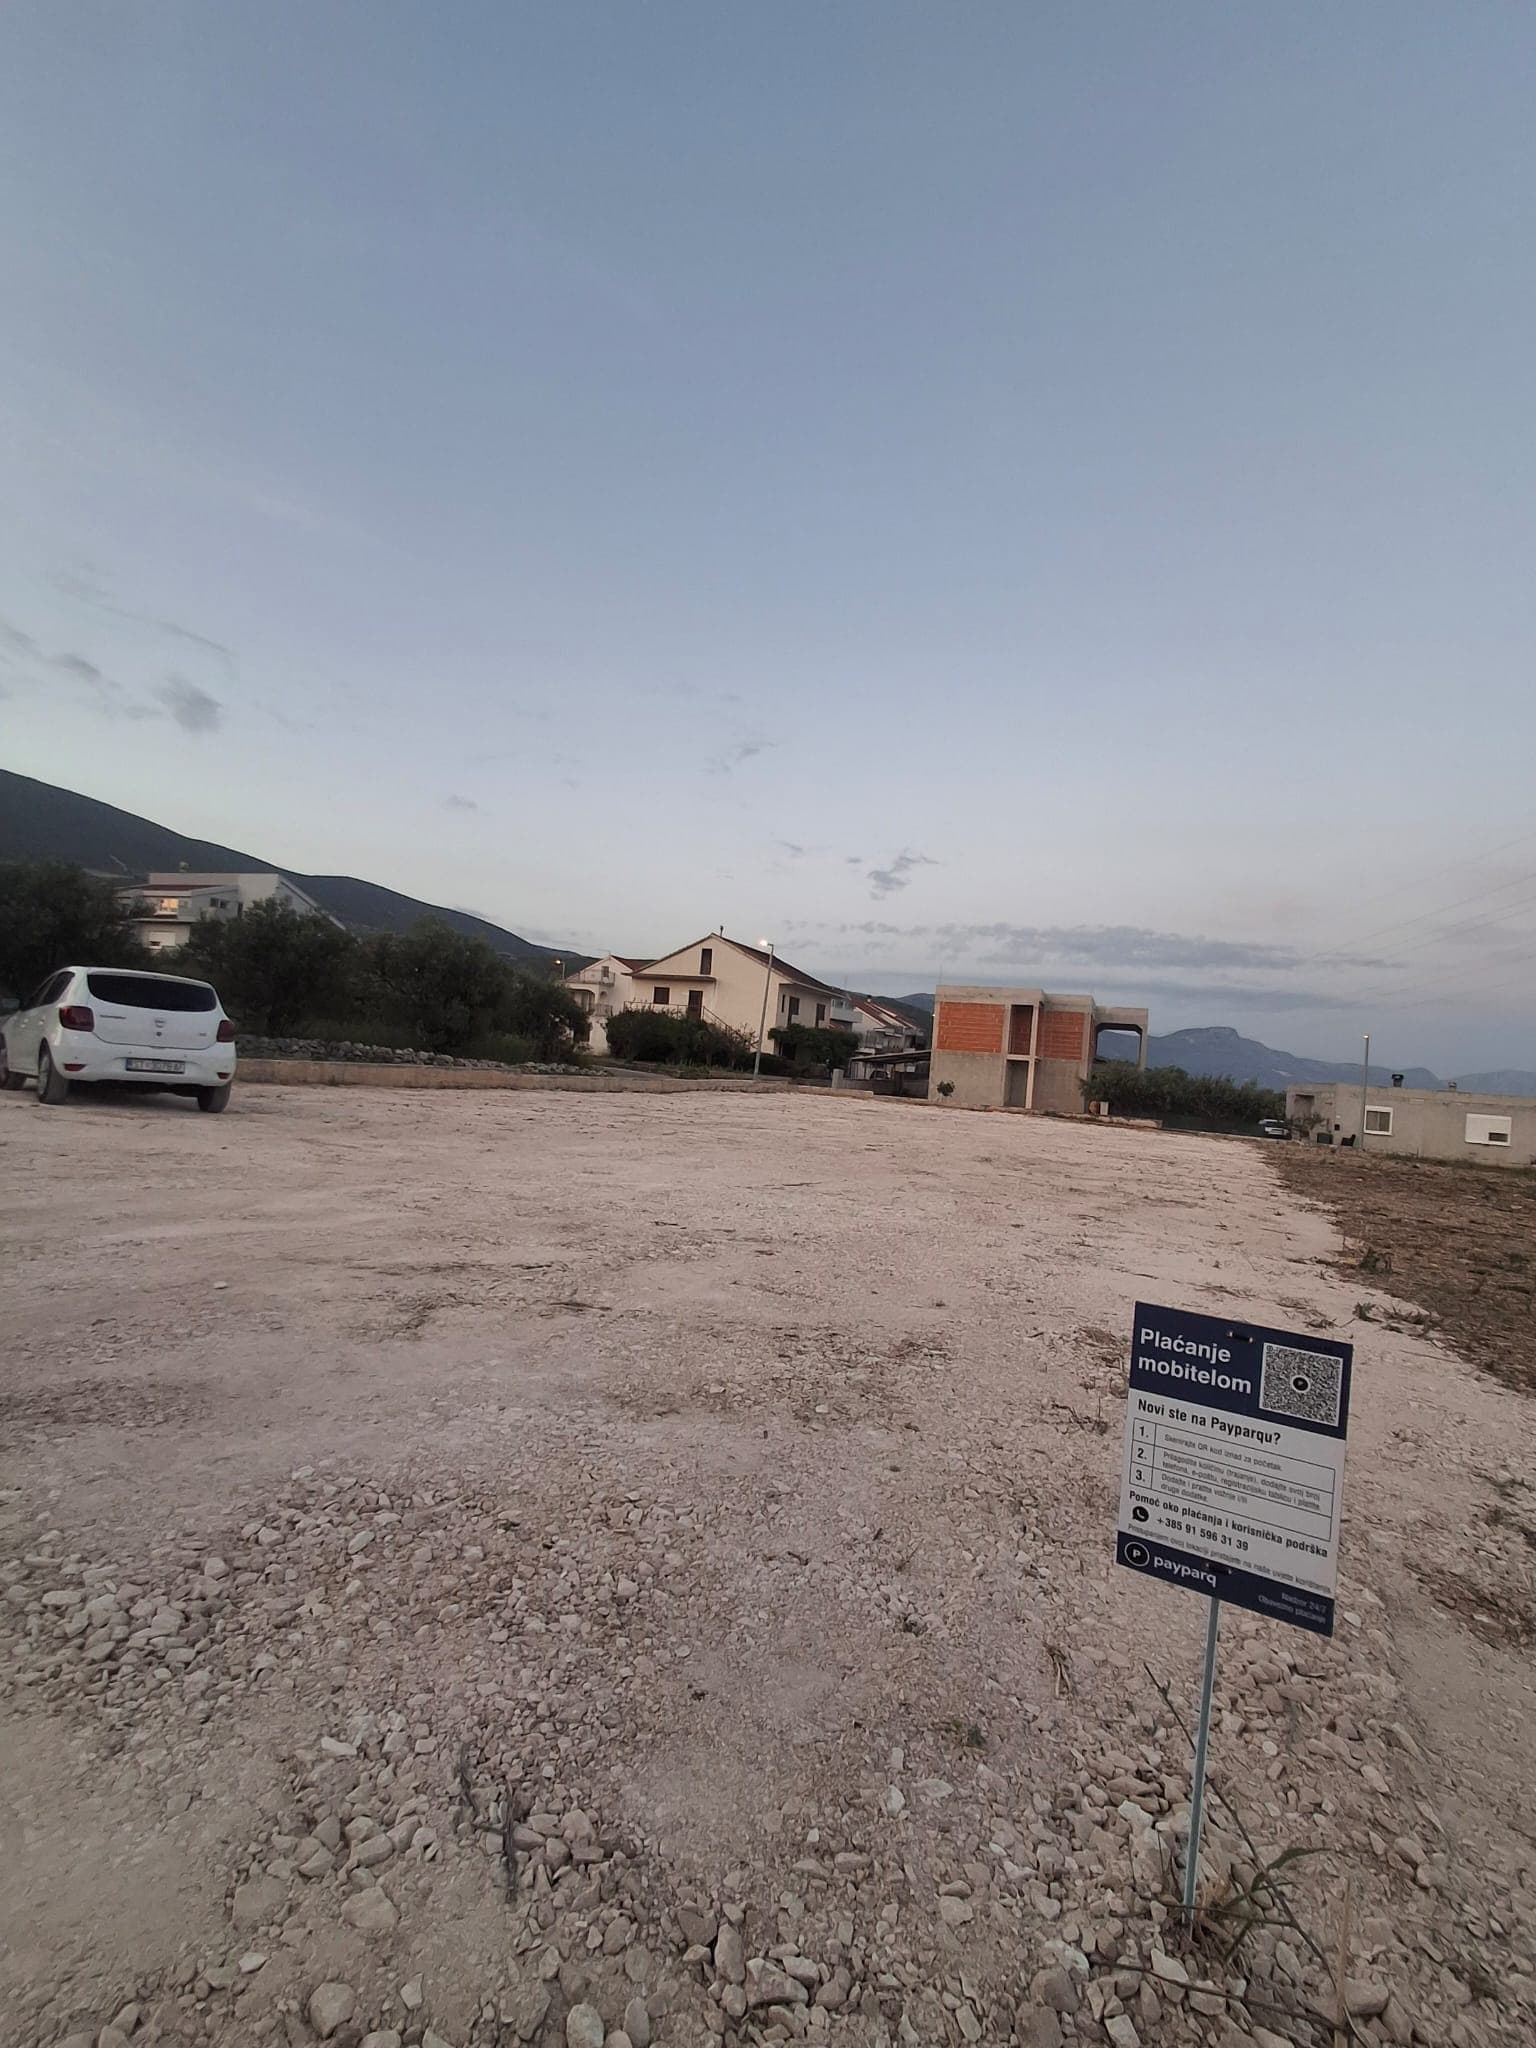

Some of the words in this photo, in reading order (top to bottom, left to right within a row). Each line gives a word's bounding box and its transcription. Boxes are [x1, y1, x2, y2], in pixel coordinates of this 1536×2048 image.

[1140, 1328, 1231, 1365] Plaćanje
[1138, 1356, 1251, 1394] mobitelom
[1138, 1398, 1165, 1416] Novi
[1169, 1408, 1187, 1421] ste
[1191, 1414, 1206, 1427] na
[1211, 1416, 1281, 1445] Payparqu?
[1139, 1425, 1149, 1438] 1.
[1137, 1447, 1148, 1460] 2.
[1135, 1469, 1146, 1482] 3.
[1129, 1490, 1160, 1507] Pomoć
[1162, 1501, 1179, 1513] oko
[1182, 1507, 1222, 1527] plaćanja
[1231, 1519, 1282, 1544] korisnička
[1286, 1538, 1328, 1558] podrška
[1156, 1517, 1182, 1531] +385
[1185, 1523, 1196, 1535] 91
[1200, 1528, 1217, 1541] 596
[1221, 1534, 1232, 1546] 31
[1236, 1539, 1249, 1551] 39
[1153, 1556, 1217, 1588] payparq
